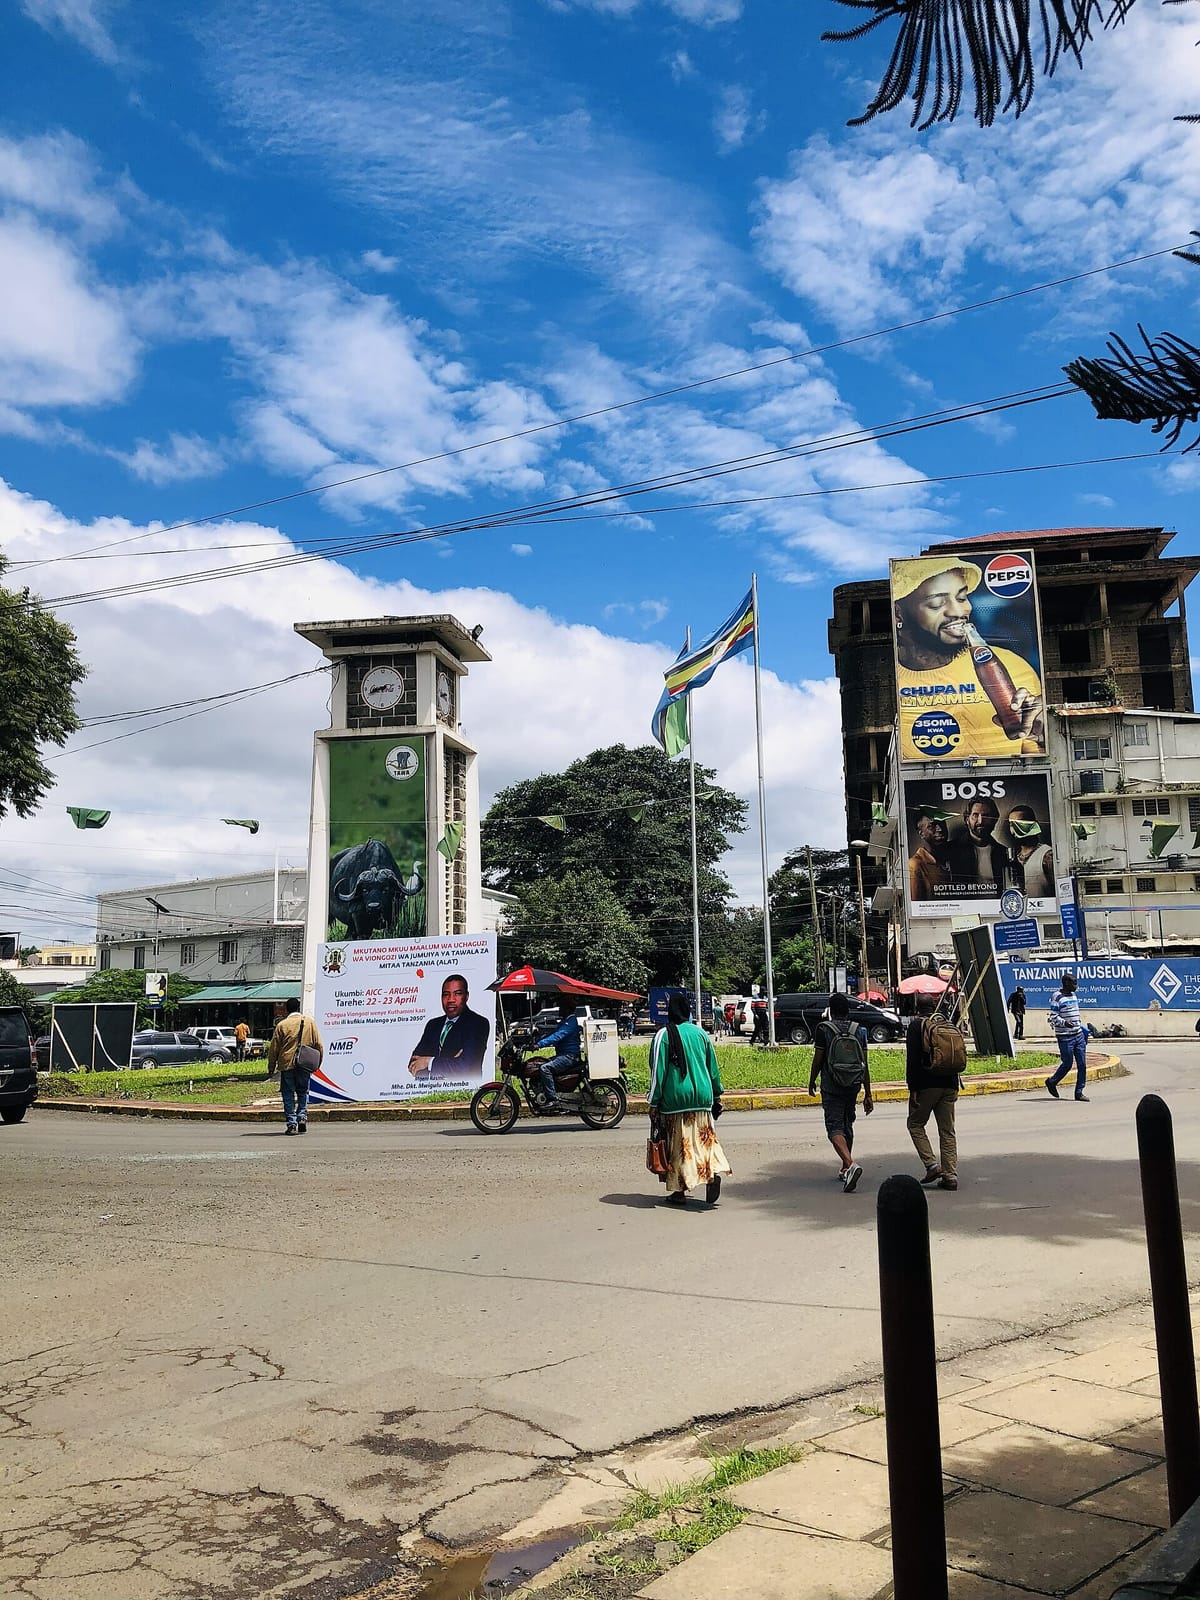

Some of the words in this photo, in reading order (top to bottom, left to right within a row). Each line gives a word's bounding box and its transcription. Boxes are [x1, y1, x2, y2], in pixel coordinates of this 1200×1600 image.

[988, 570, 1030, 582] PEPSI
[900, 684, 956, 697] CHUPA
[959, 684, 976, 693] NI
[915, 718, 956, 728] 350ML
[914, 734, 964, 748] 600
[942, 780, 1006, 800] BOSS
[453, 940, 487, 949] UCHAGUZI
[410, 952, 439, 960] JUMUIYA
[402, 960, 435, 968] TANZANIA
[436, 958, 459, 967] (ALAT)
[1012, 966, 1072, 980] TANZANITE
[1077, 965, 1134, 978] MUSEUM
[388, 986, 419, 995] ARUSHA
[1090, 985, 1110, 993] Mystery
[336, 999, 364, 1007] Tarehe:
[394, 995, 417, 1005] Aprili
[330, 1041, 353, 1050] NMB
